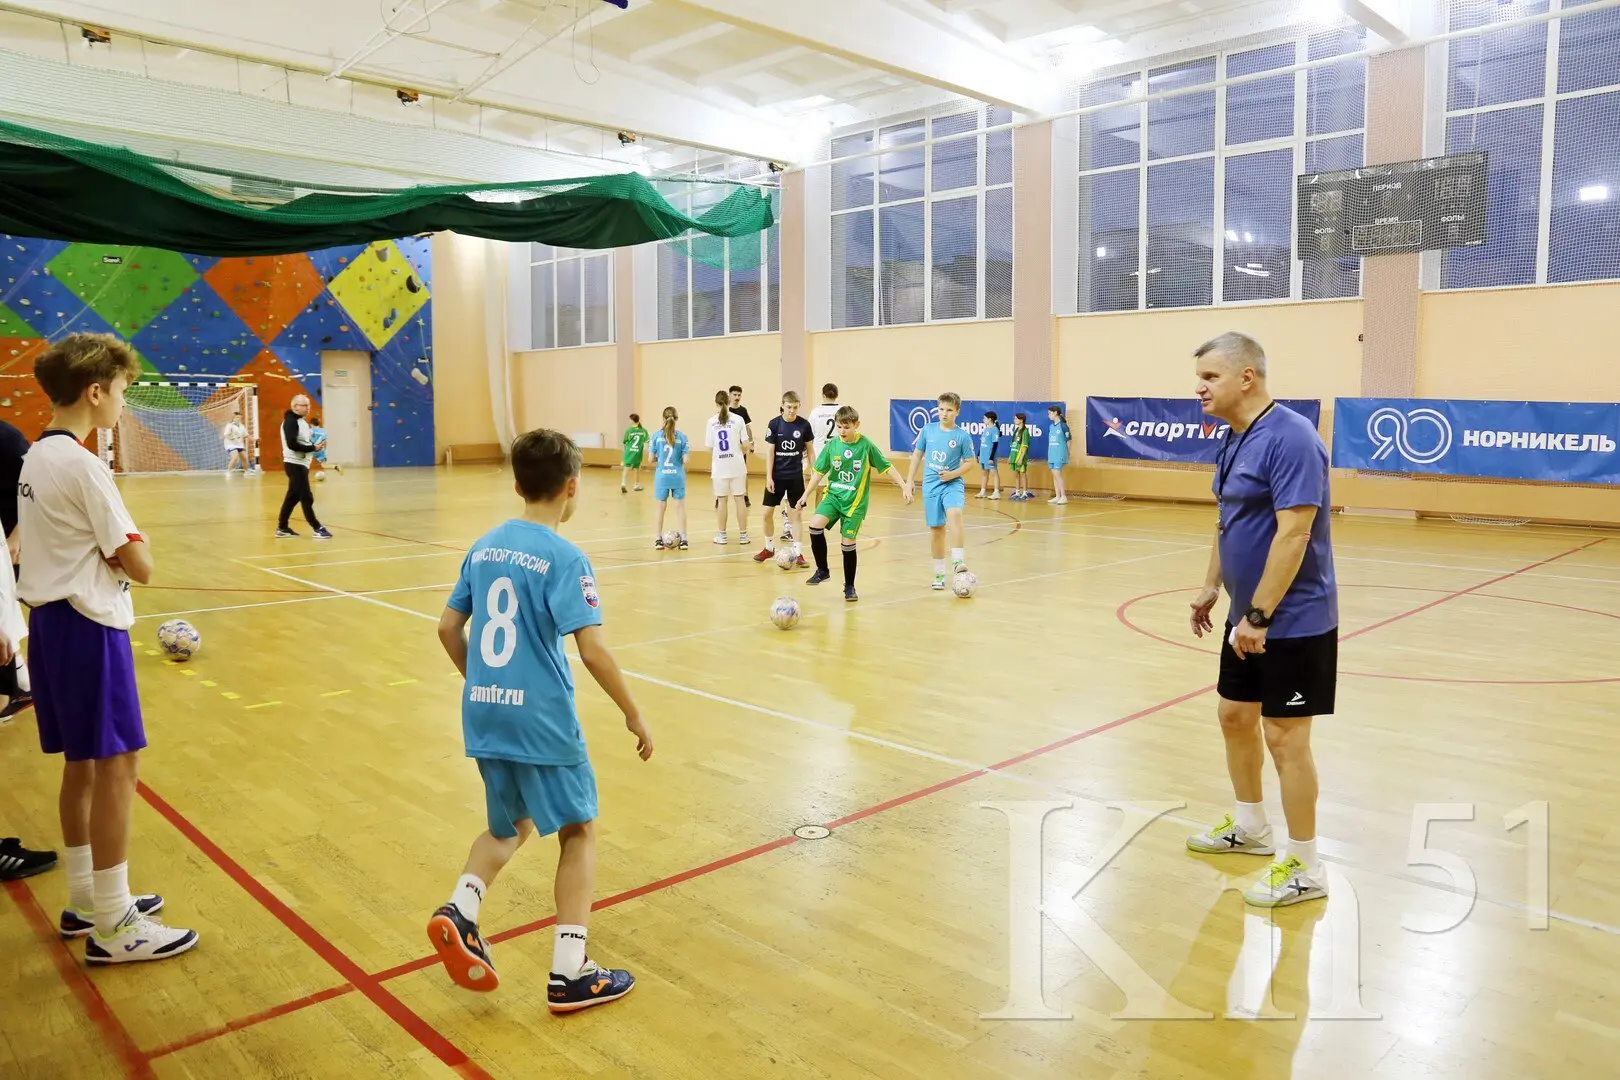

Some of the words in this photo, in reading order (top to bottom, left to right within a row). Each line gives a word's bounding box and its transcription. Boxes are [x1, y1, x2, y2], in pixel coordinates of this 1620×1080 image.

[1372, 183, 1402, 192] ПЕРИОД
[1374, 216, 1399, 225] ВРЕМЯ
[826, 418, 836, 439] 2
[1367, 407, 1453, 464] 90
[1463, 430, 1616, 452] НОРНИКЕЛЬ
[631, 435, 640, 448] 2
[718, 430, 729, 451] 8
[663, 444, 674, 467] 2
[510, 551, 550, 575] РОССИИ
[480, 576, 520, 668] 8
[470, 685, 524, 706] amfr.ru
